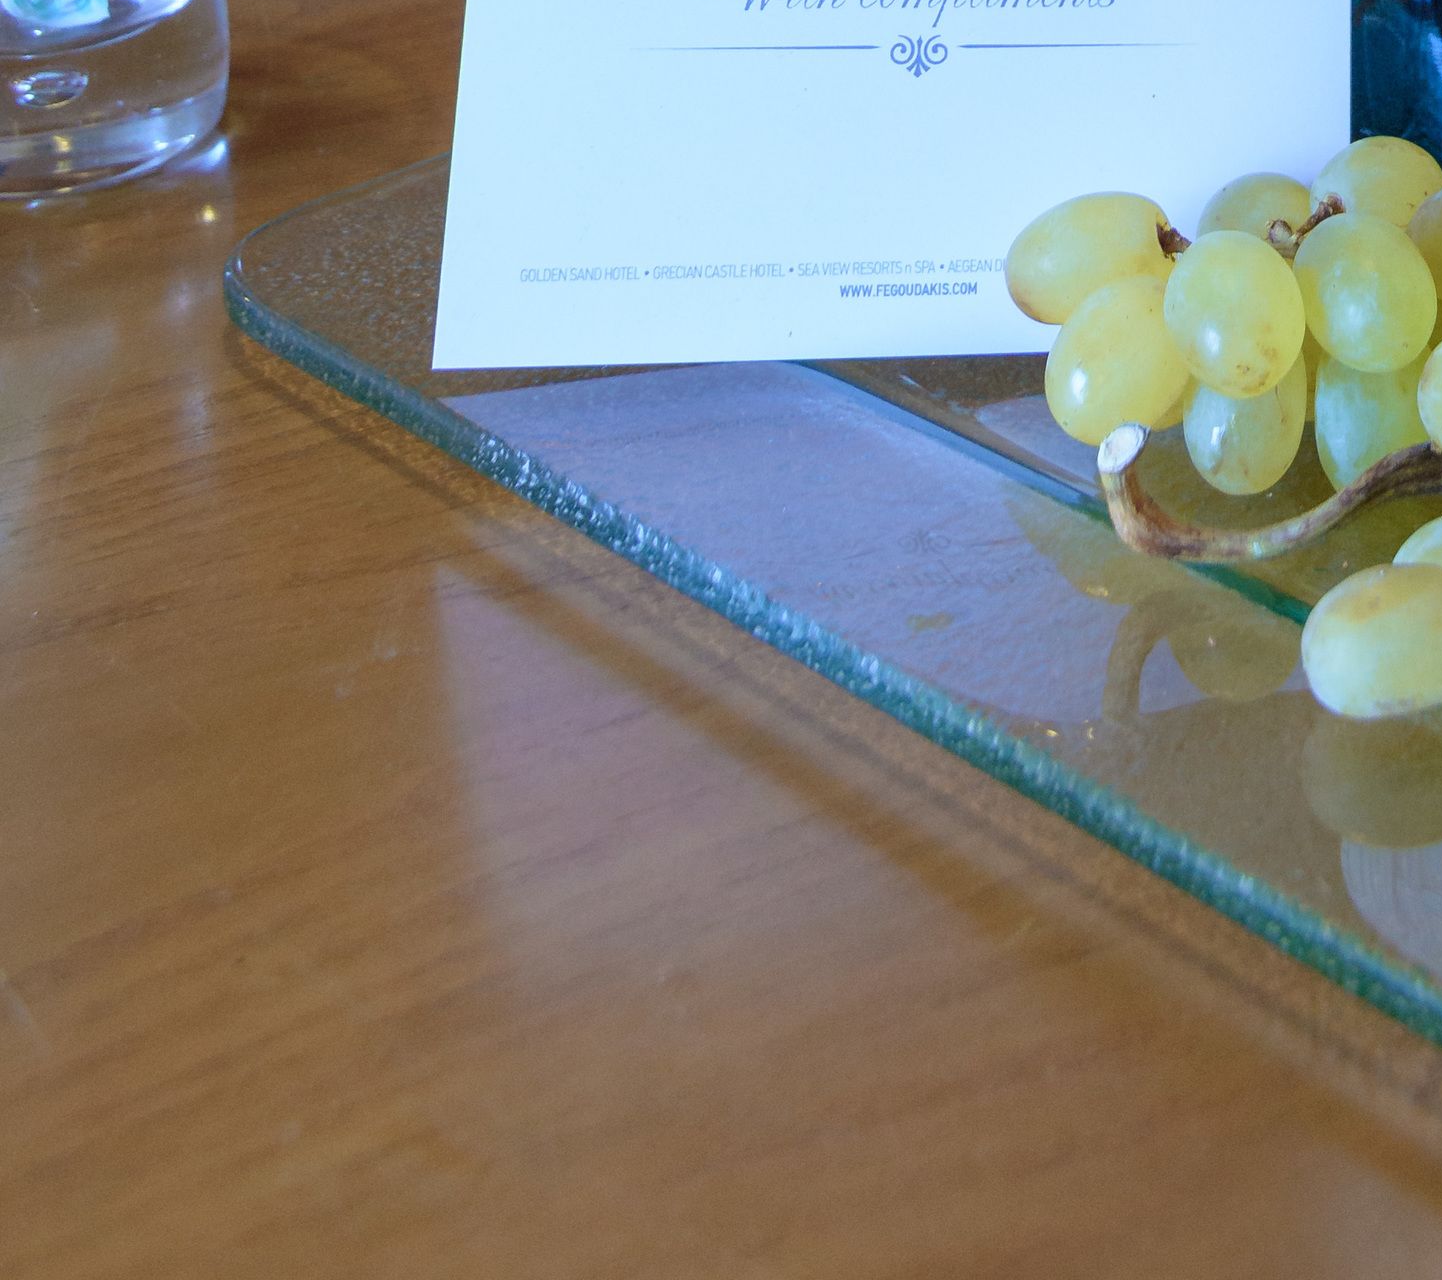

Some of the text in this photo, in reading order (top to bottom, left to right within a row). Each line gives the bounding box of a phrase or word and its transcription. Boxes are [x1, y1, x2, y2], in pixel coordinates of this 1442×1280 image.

[519, 267, 567, 283] GOLDEN
[568, 267, 602, 281] SAND
[604, 266, 640, 281] HOTEL
[652, 265, 703, 280] GRECIAN
[704, 264, 748, 279] CASTLE
[749, 263, 786, 278] HOTEL
[797, 262, 820, 277] SEA
[822, 262, 851, 277] VIEW
[852, 260, 901, 276] RESORTS
[914, 259, 936, 275] SPA
[947, 259, 992, 273] AEGEAN
[839, 281, 979, 298] WWW.FEGOUDAKIS.COM
